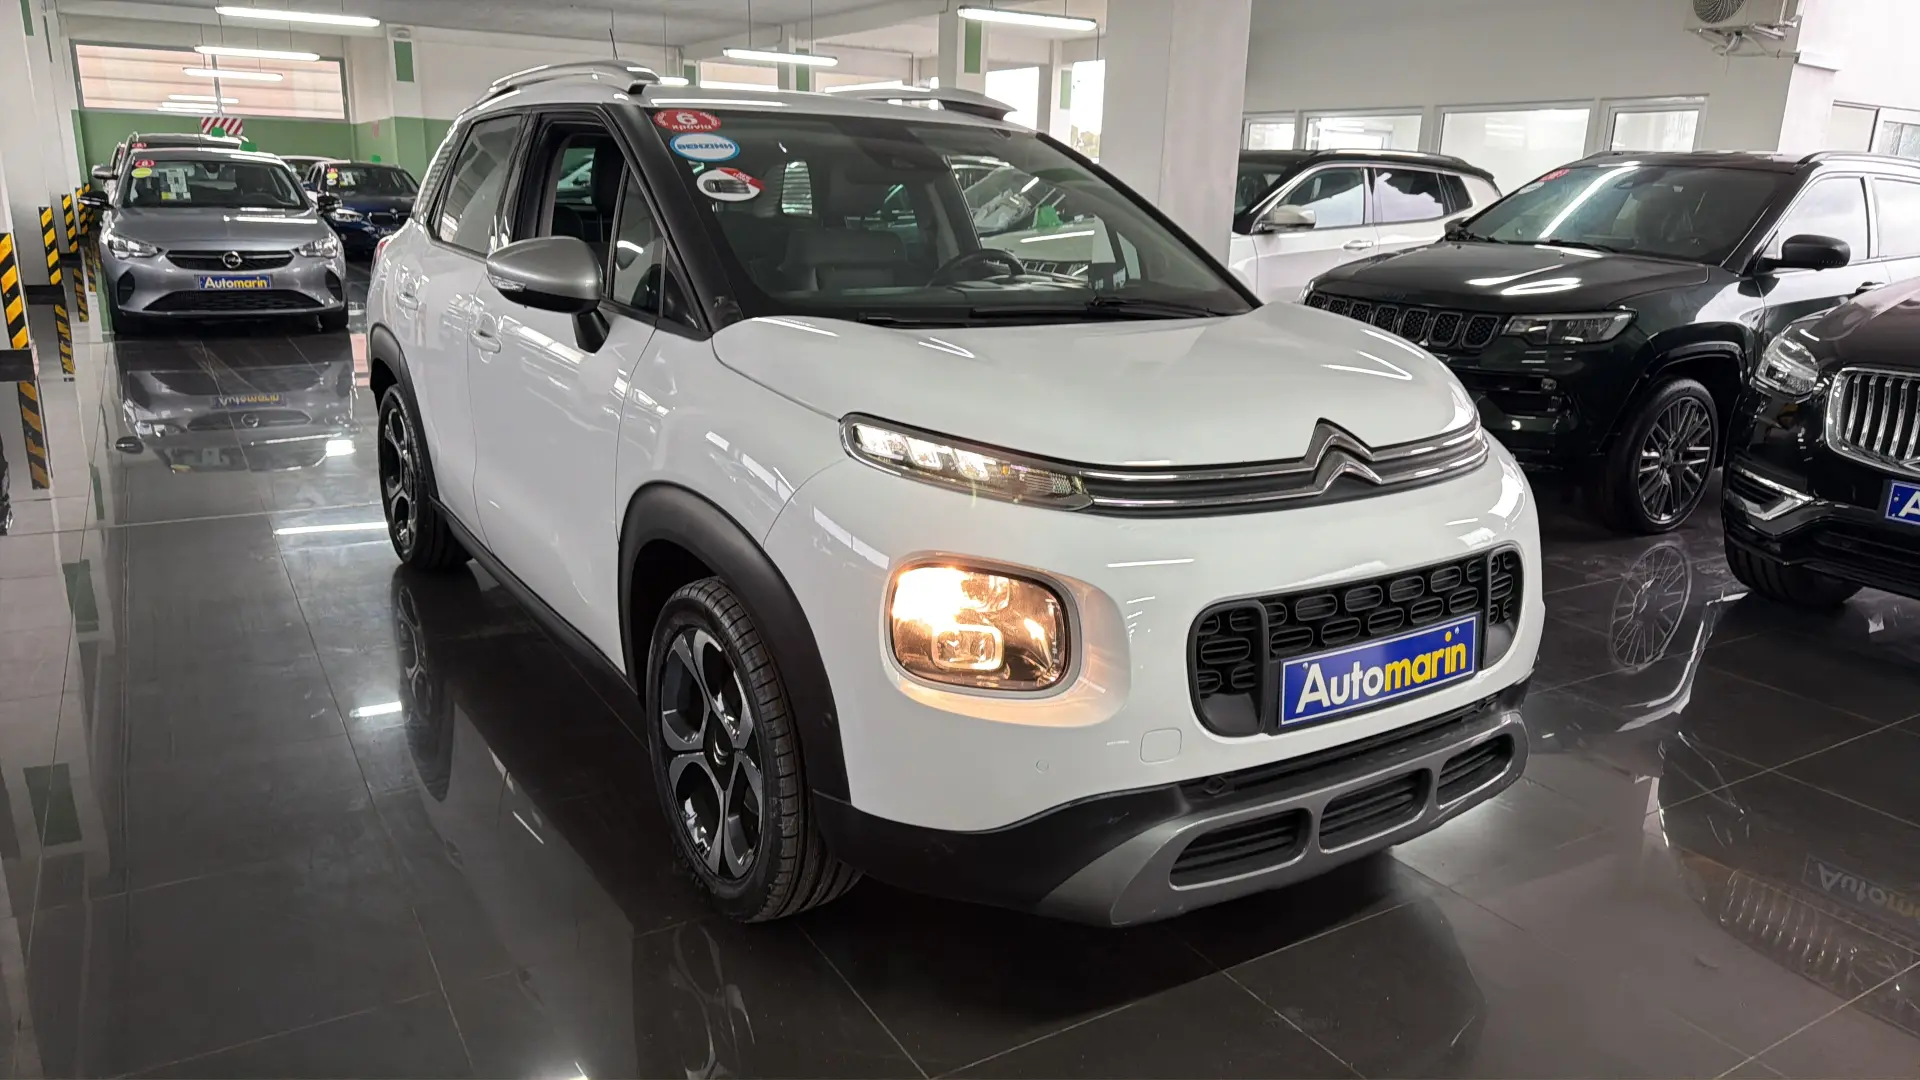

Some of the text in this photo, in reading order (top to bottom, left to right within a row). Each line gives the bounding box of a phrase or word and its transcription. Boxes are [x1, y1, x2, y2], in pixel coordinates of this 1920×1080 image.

[676, 111, 698, 125] 6
[204, 276, 267, 289] Automarin
[1295, 631, 1467, 714] Automarin
